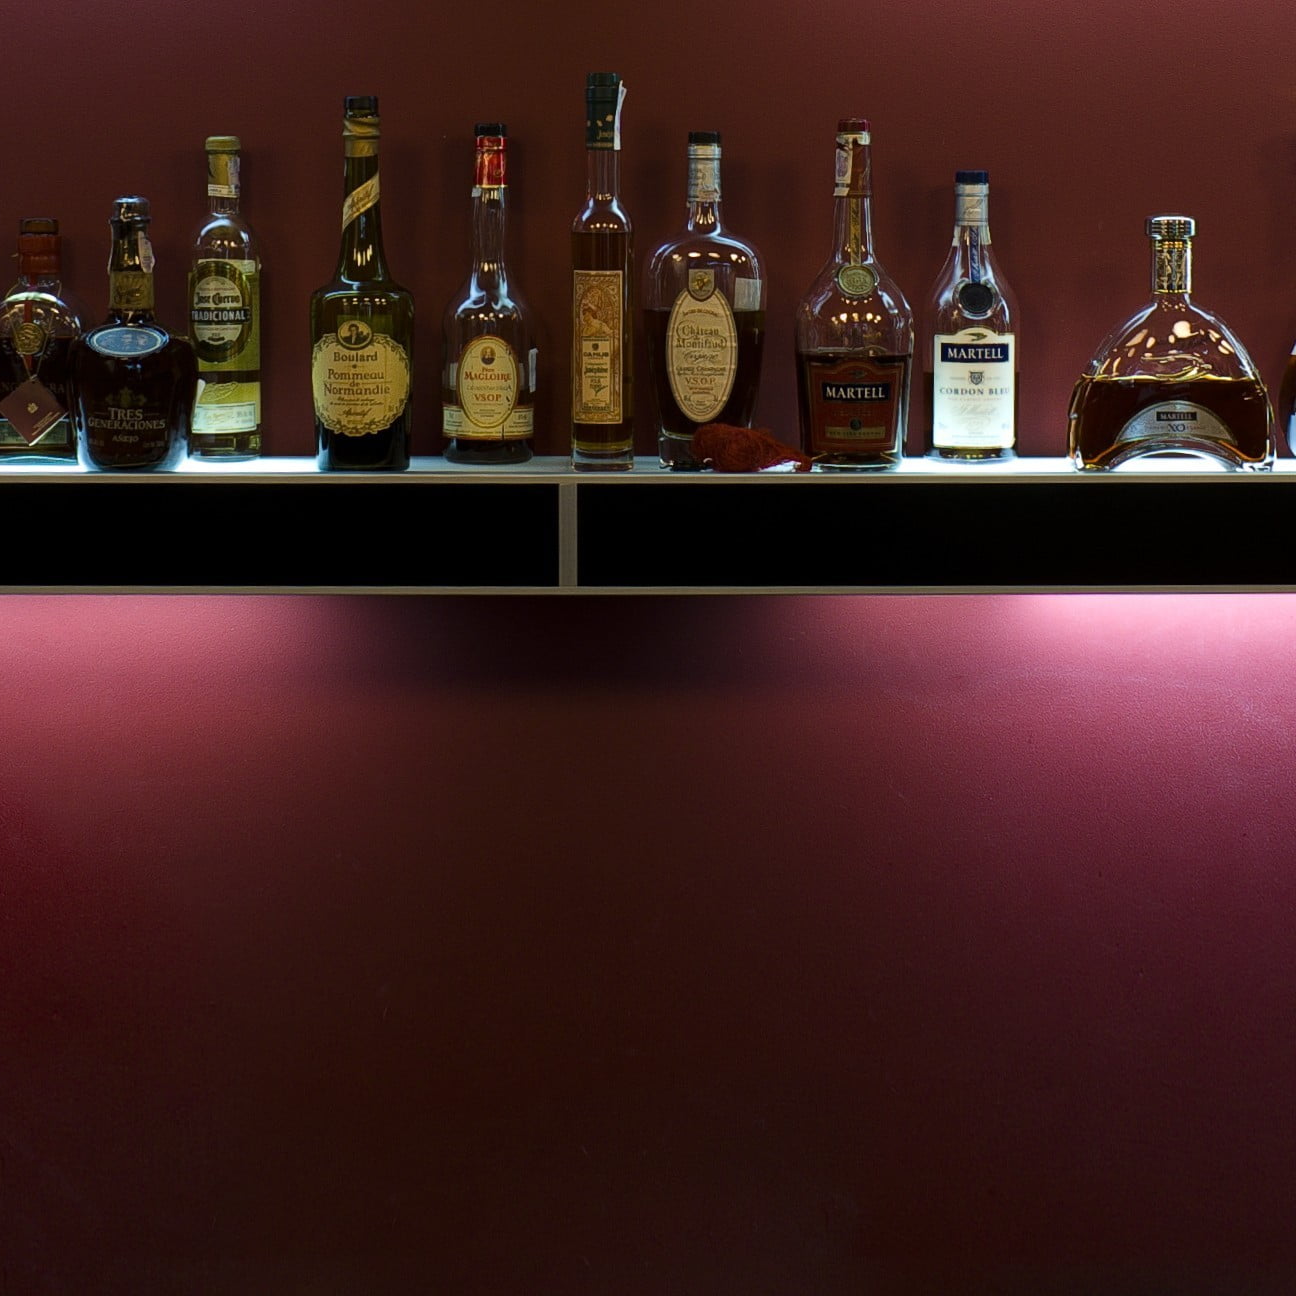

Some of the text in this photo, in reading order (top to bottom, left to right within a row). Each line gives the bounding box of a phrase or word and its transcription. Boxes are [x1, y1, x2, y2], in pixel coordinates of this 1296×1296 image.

[191, 310, 247, 322] TRADICIONAL
[333, 351, 378, 363] Boulard
[947, 347, 1005, 360] MARTELL
[327, 368, 385, 381] Pommeau
[464, 371, 513, 383] MAGLOIRE
[323, 384, 392, 397] Normandie
[825, 386, 886, 400] MARTELL
[939, 387, 1010, 396] CORDON BLEU
[474, 394, 502, 402] VSOP
[107, 407, 144, 421] TRES
[88, 416, 167, 431] GENERACIONES
[1168, 423, 1186, 433] XO
